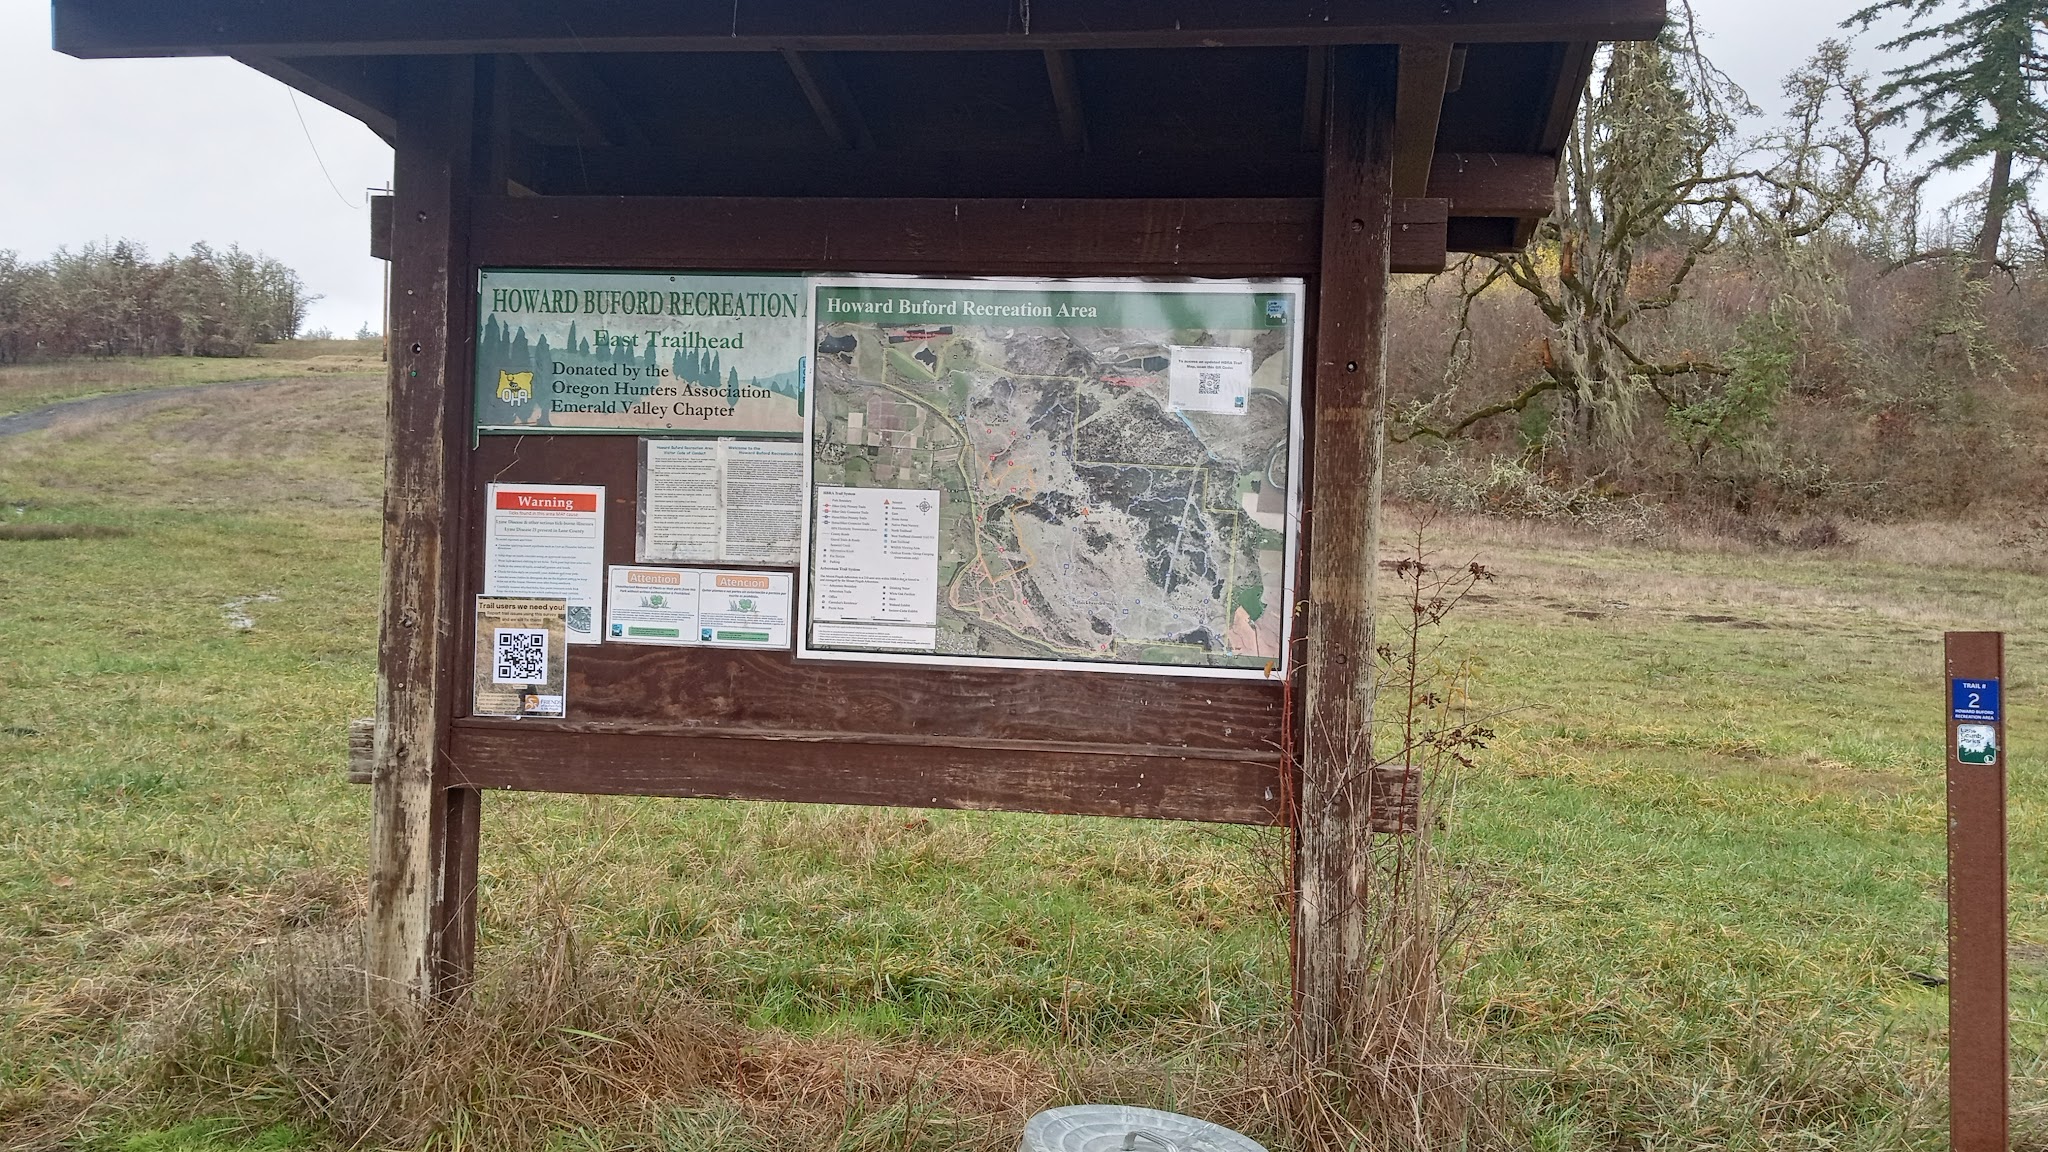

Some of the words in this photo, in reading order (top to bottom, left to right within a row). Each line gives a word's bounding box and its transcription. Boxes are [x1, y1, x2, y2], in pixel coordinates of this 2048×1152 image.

[492, 288, 578, 314] HOWARD
[583, 290, 663, 316] BUFORD
[669, 291, 798, 318] RECREATION
[827, 298, 893, 314] Howard
[898, 299, 957, 316] Buford
[963, 300, 1052, 317] Recreation
[1056, 302, 1097, 318] Area
[593, 329, 638, 347] East
[645, 329, 744, 350] Trailhead
[552, 362, 618, 377] Donated
[622, 361, 641, 380] by
[645, 362, 669, 377] the
[552, 381, 609, 398] Oregon
[614, 382, 677, 397] Hunters
[682, 383, 772, 399] Association
[551, 400, 617, 414] Emerald
[621, 400, 668, 419] Valley
[672, 402, 736, 420] Chapter
[518, 495, 574, 510] Warning
[630, 573, 678, 584] Attention
[720, 577, 765, 588] Atención
[1968, 692, 1980, 709] 2
